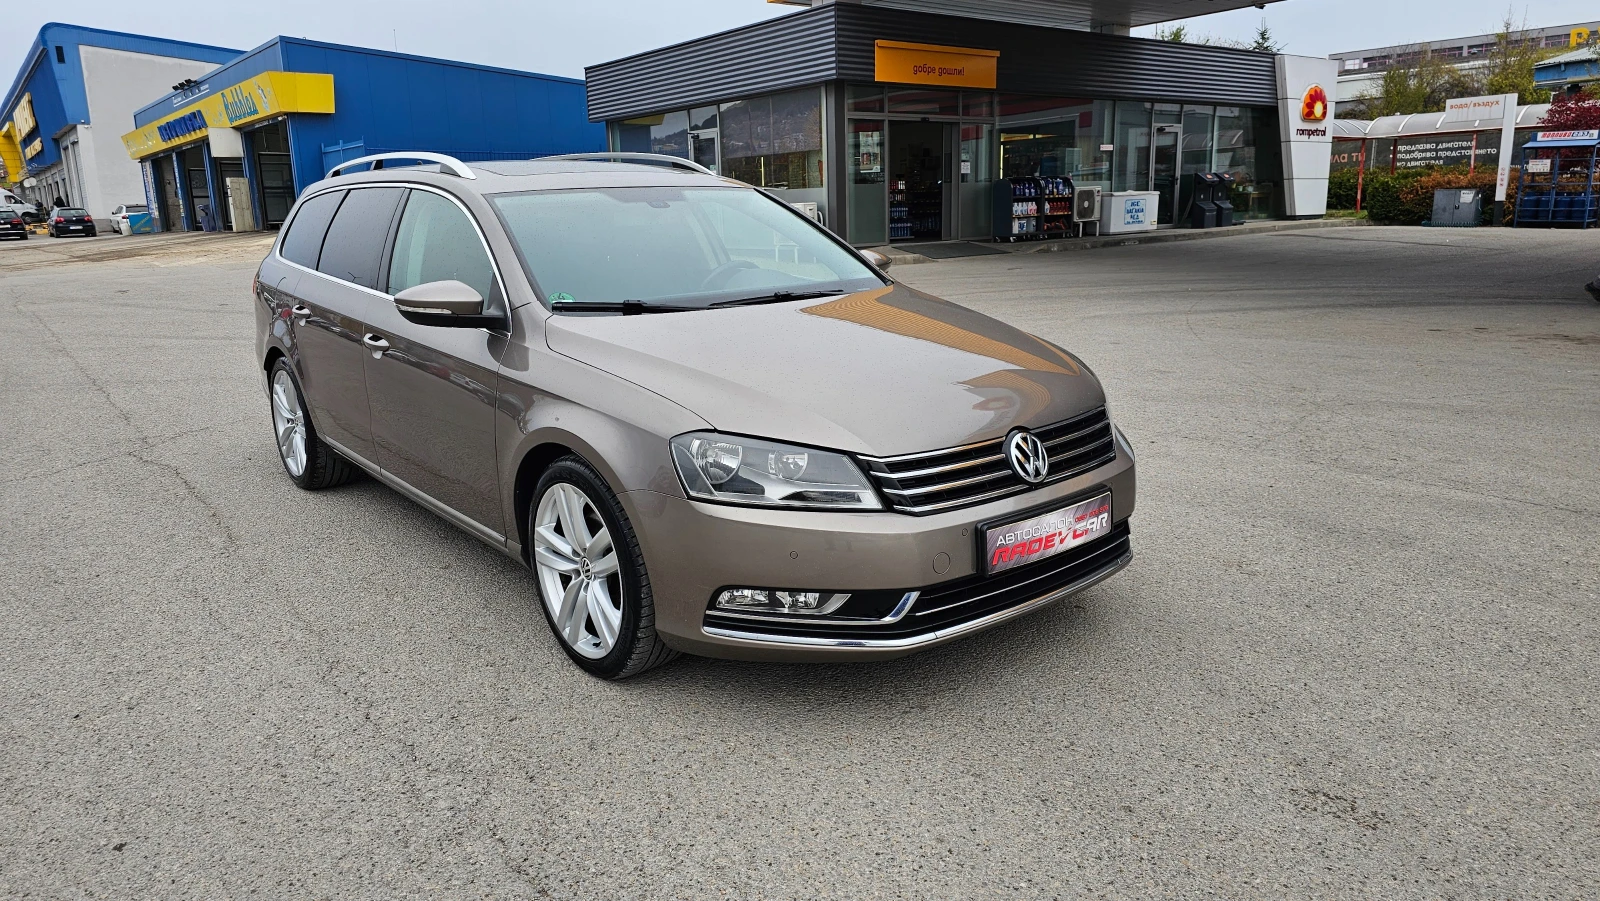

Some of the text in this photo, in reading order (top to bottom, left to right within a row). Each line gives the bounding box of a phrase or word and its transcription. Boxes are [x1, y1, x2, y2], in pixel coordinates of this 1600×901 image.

[913, 64, 965, 77] добре дошли!
[1296, 126, 1327, 139] rompetrol
[996, 514, 1073, 547] АВТОСАЛОН
